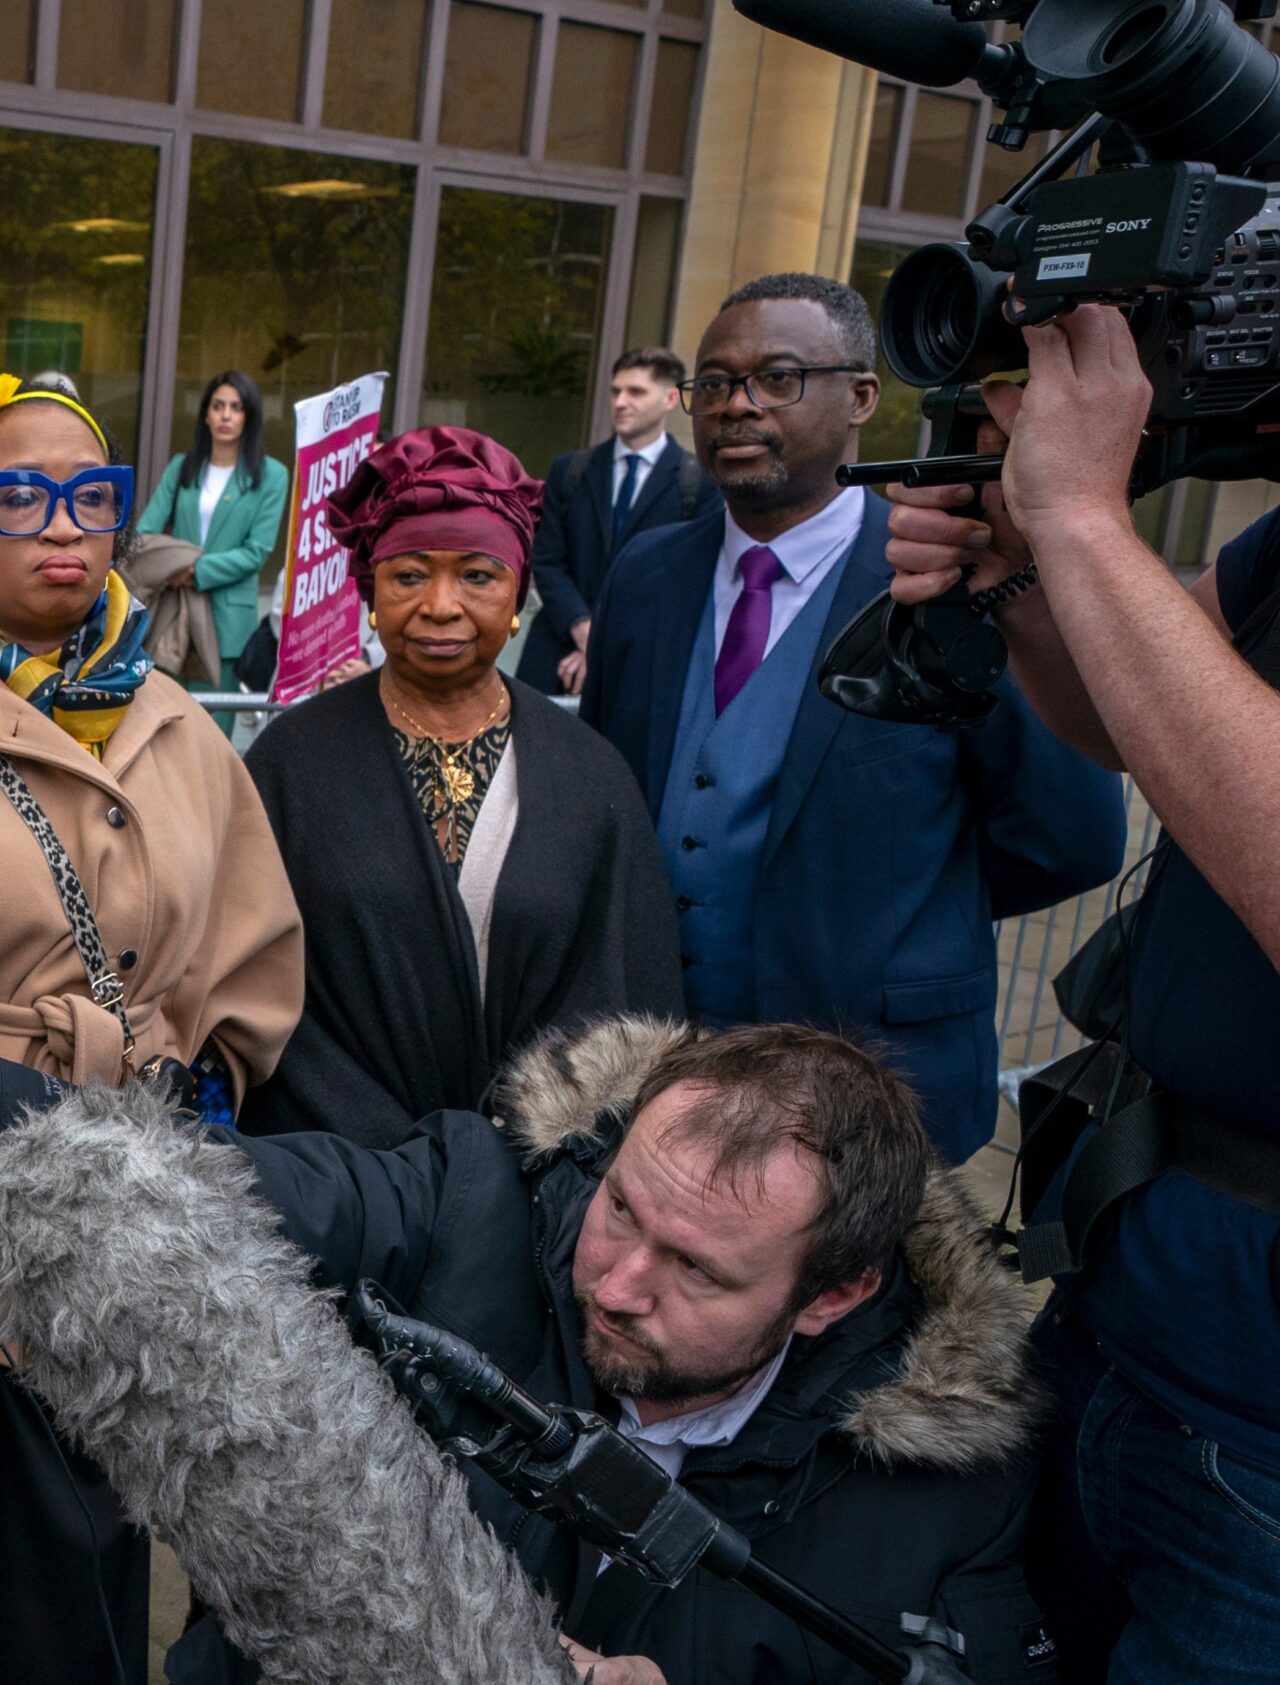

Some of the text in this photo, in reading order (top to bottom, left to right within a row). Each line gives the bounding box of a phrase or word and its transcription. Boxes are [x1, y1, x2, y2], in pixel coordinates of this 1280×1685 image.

[1105, 218, 1152, 233] SONY
[1042, 260, 1085, 272] PXW-FX9-10
[298, 516, 311, 563] 4
